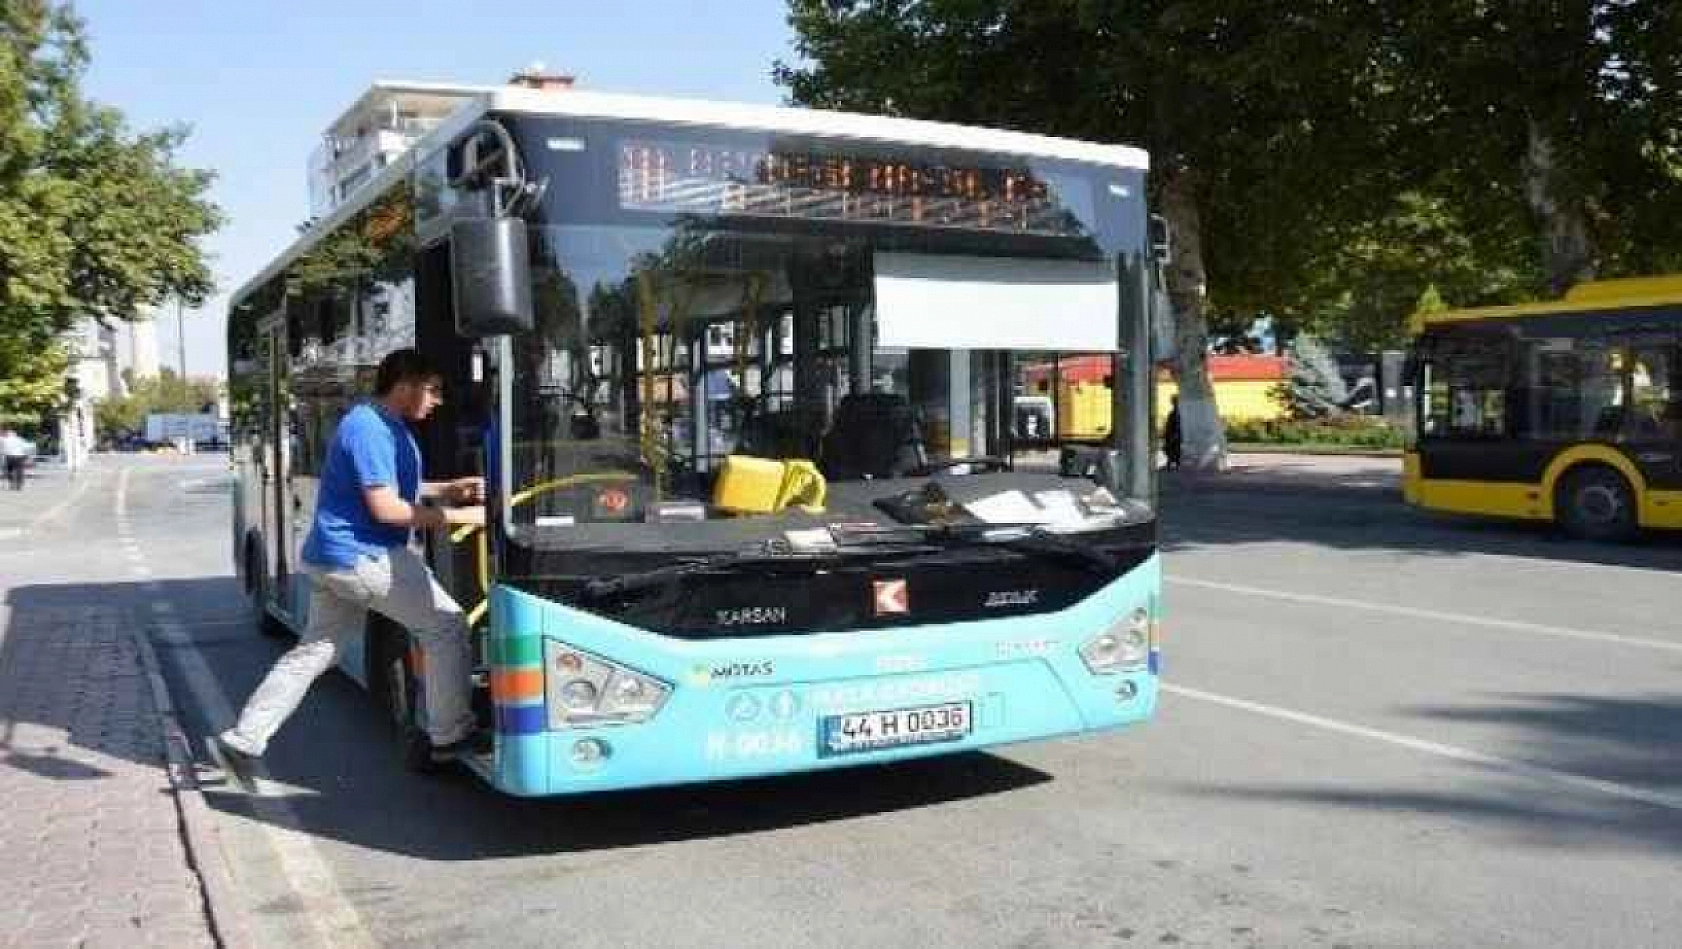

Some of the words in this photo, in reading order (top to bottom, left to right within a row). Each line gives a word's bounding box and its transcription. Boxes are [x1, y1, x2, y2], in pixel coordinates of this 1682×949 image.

[716, 605, 787, 625] KARSAN
[843, 715, 873, 739] 44
[880, 713, 899, 736] H
[907, 708, 963, 733] 0036
